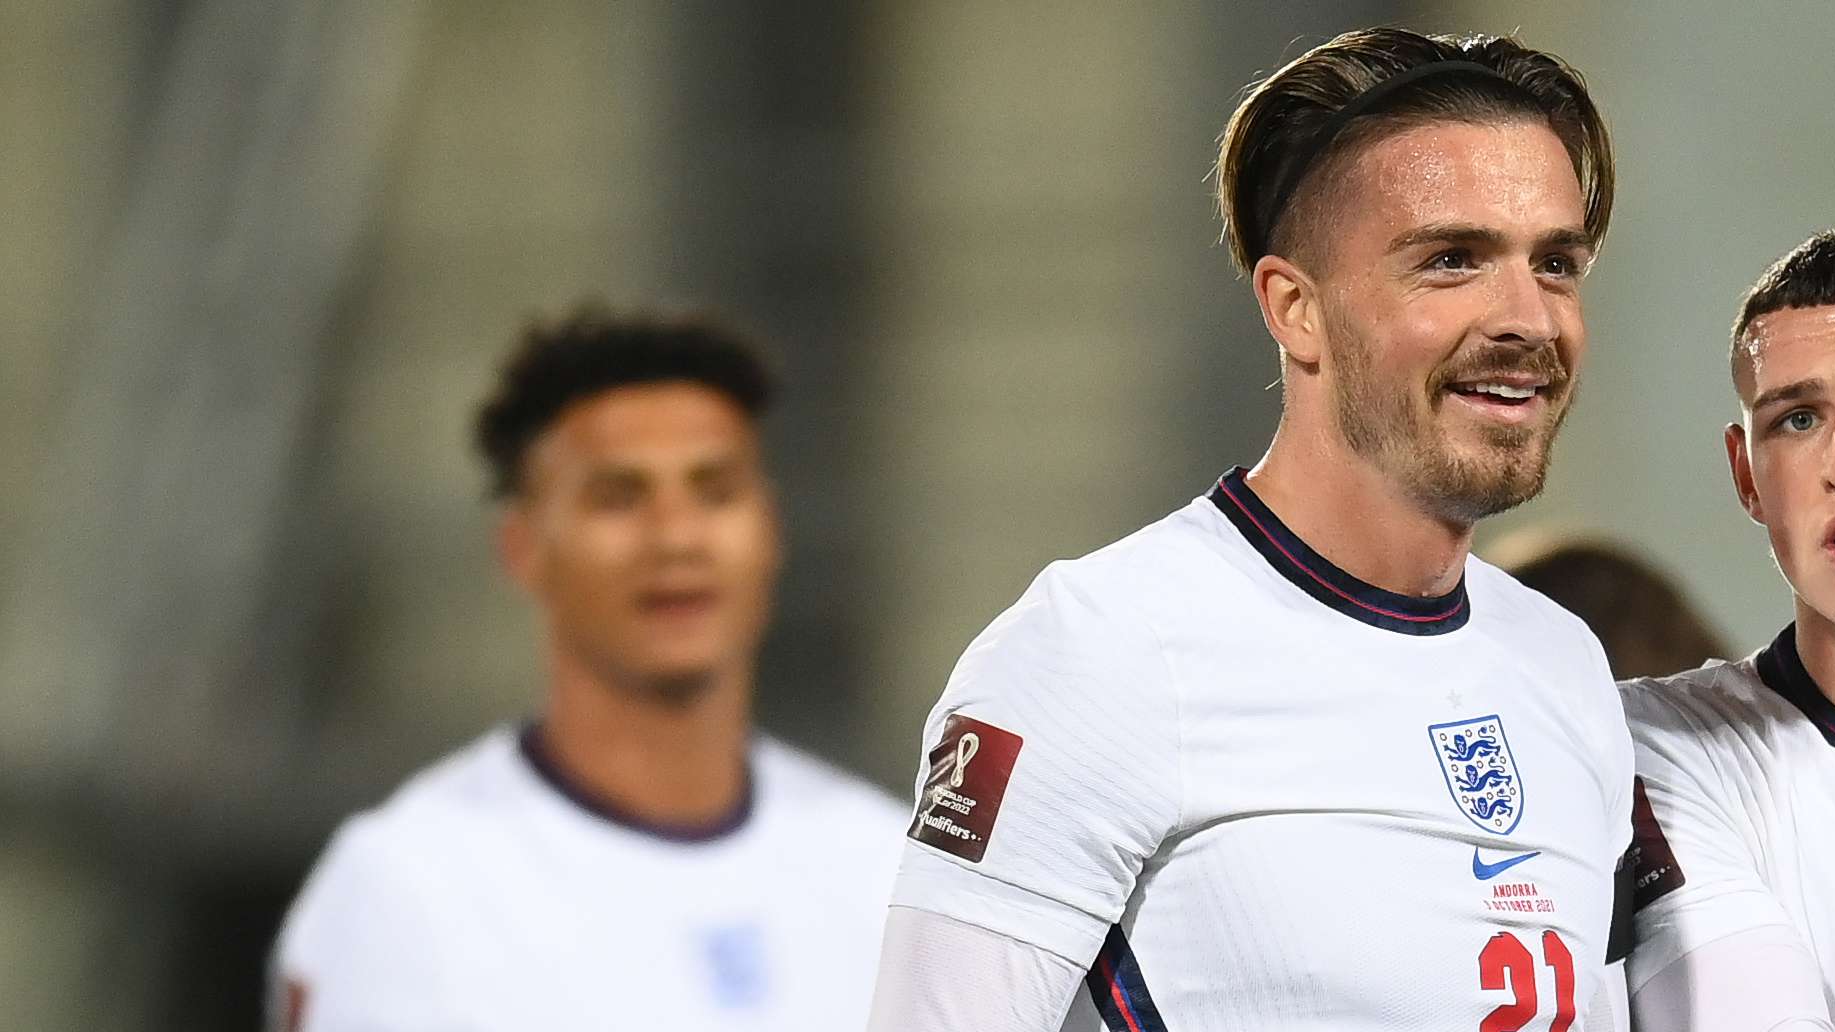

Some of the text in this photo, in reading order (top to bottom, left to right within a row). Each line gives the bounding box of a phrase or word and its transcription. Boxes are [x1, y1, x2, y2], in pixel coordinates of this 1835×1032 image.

[1493, 882, 1538, 898] ANDORRA
[1491, 899, 1535, 913] OCTOBER
[1535, 898, 1556, 913] 2021
